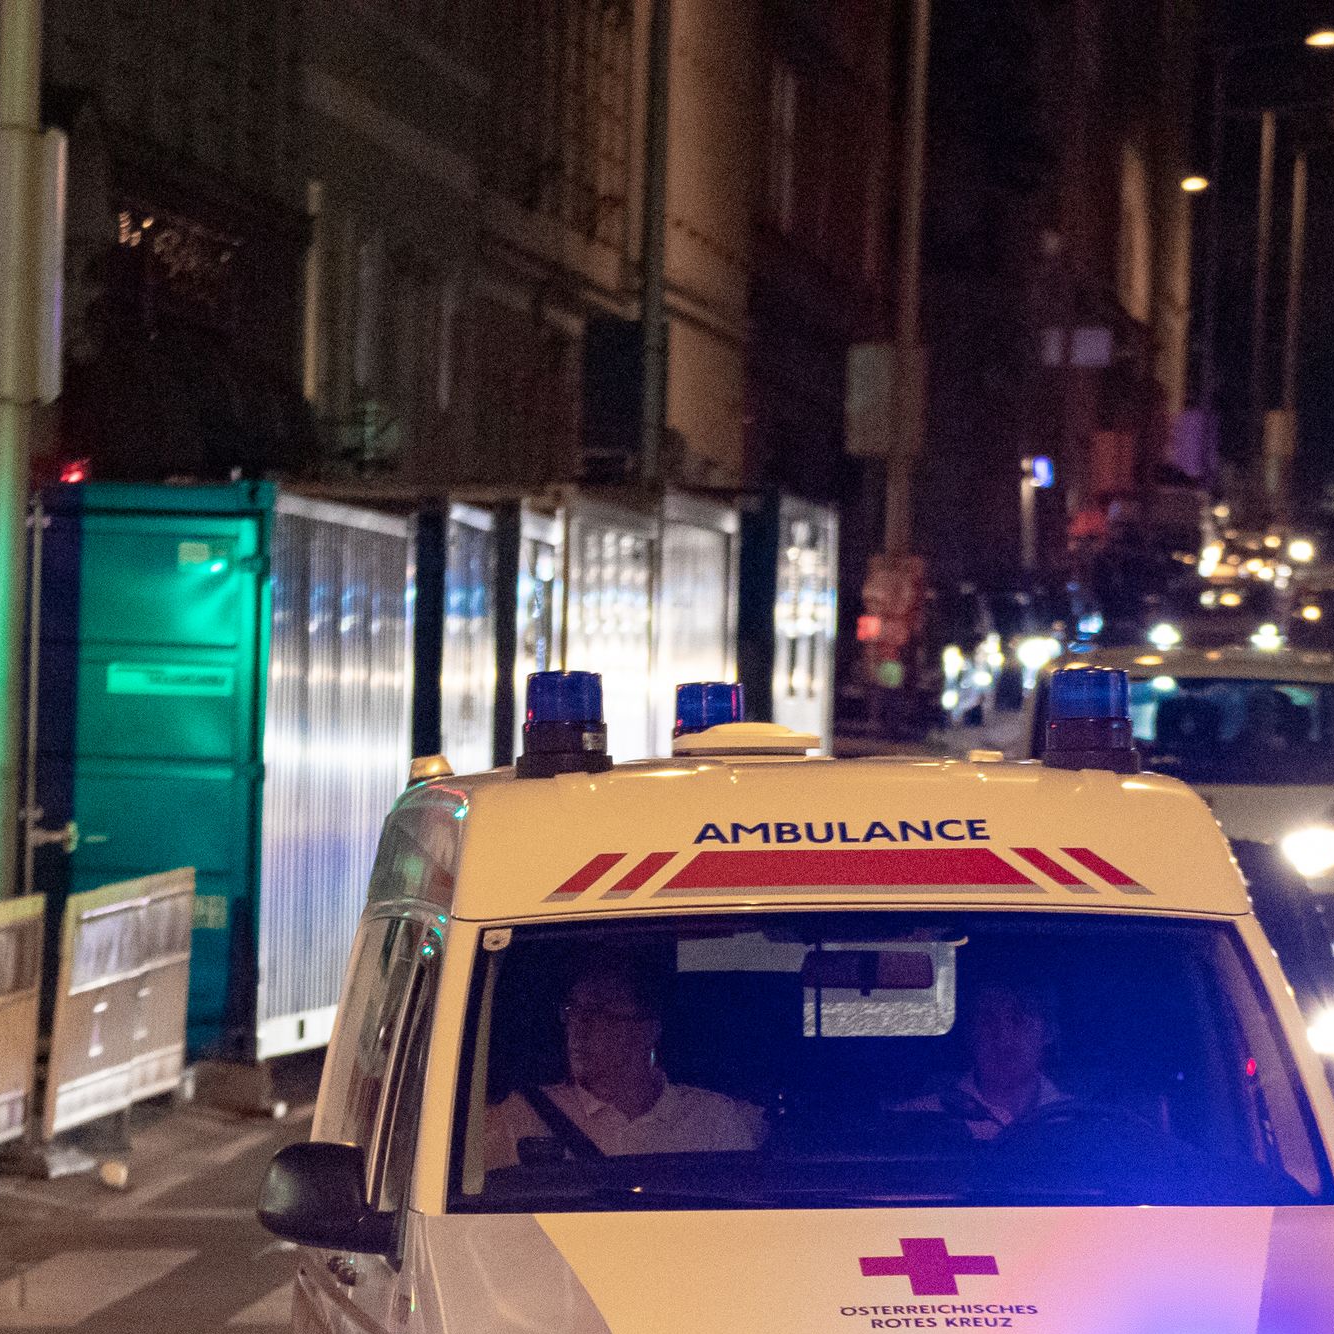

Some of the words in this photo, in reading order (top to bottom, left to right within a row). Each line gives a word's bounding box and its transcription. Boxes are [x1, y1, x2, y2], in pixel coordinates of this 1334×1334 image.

[692, 819, 990, 844] AMBULANCE
[840, 1304, 1038, 1316] ÖSTERREICHISCHES
[871, 1317, 937, 1329] ROTES
[945, 1317, 1013, 1328] KREUZ
